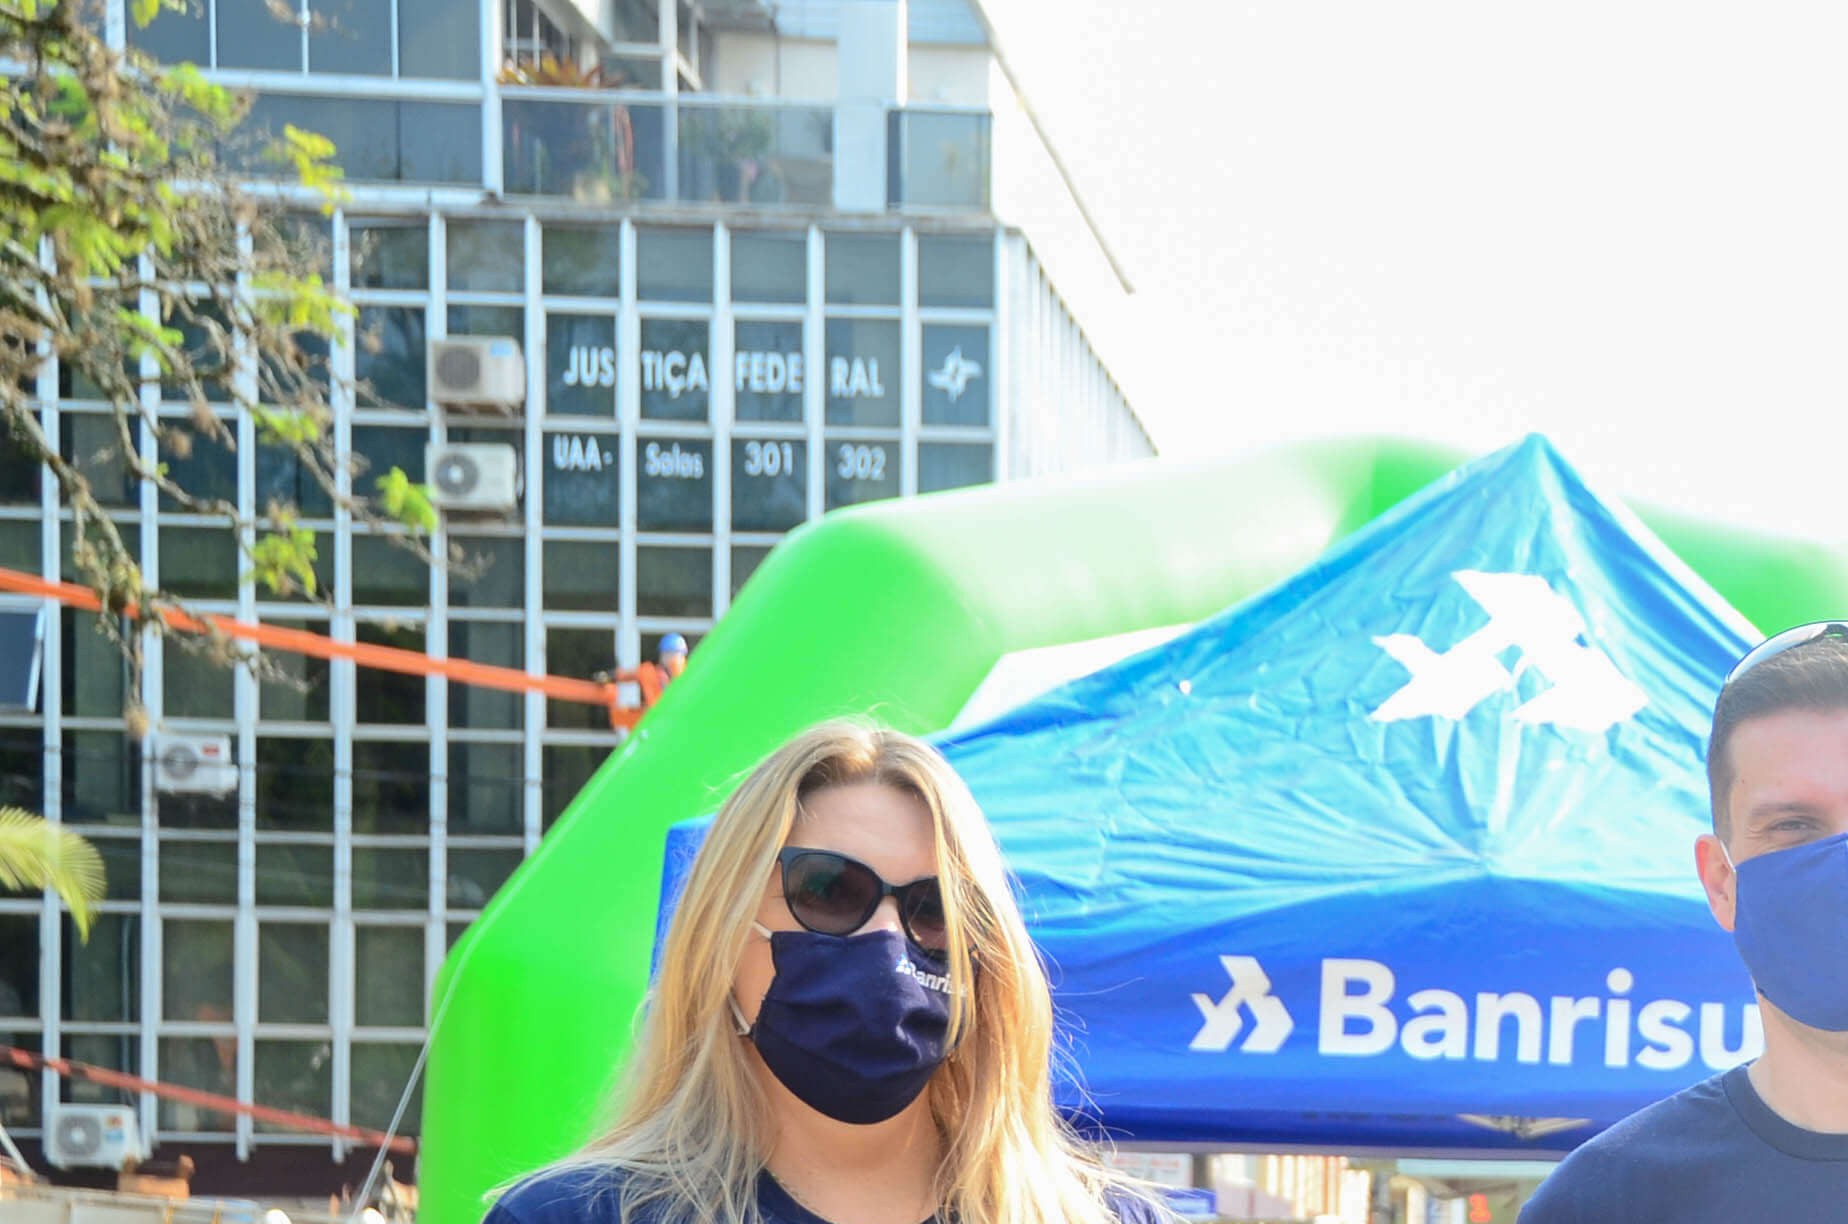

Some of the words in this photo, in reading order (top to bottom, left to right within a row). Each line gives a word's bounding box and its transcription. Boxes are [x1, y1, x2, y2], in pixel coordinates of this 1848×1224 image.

[646, 441, 704, 479] Salas
[744, 441, 793, 477] 301
[837, 443, 887, 481] 302
[1318, 957, 1766, 1071] Banrisu
